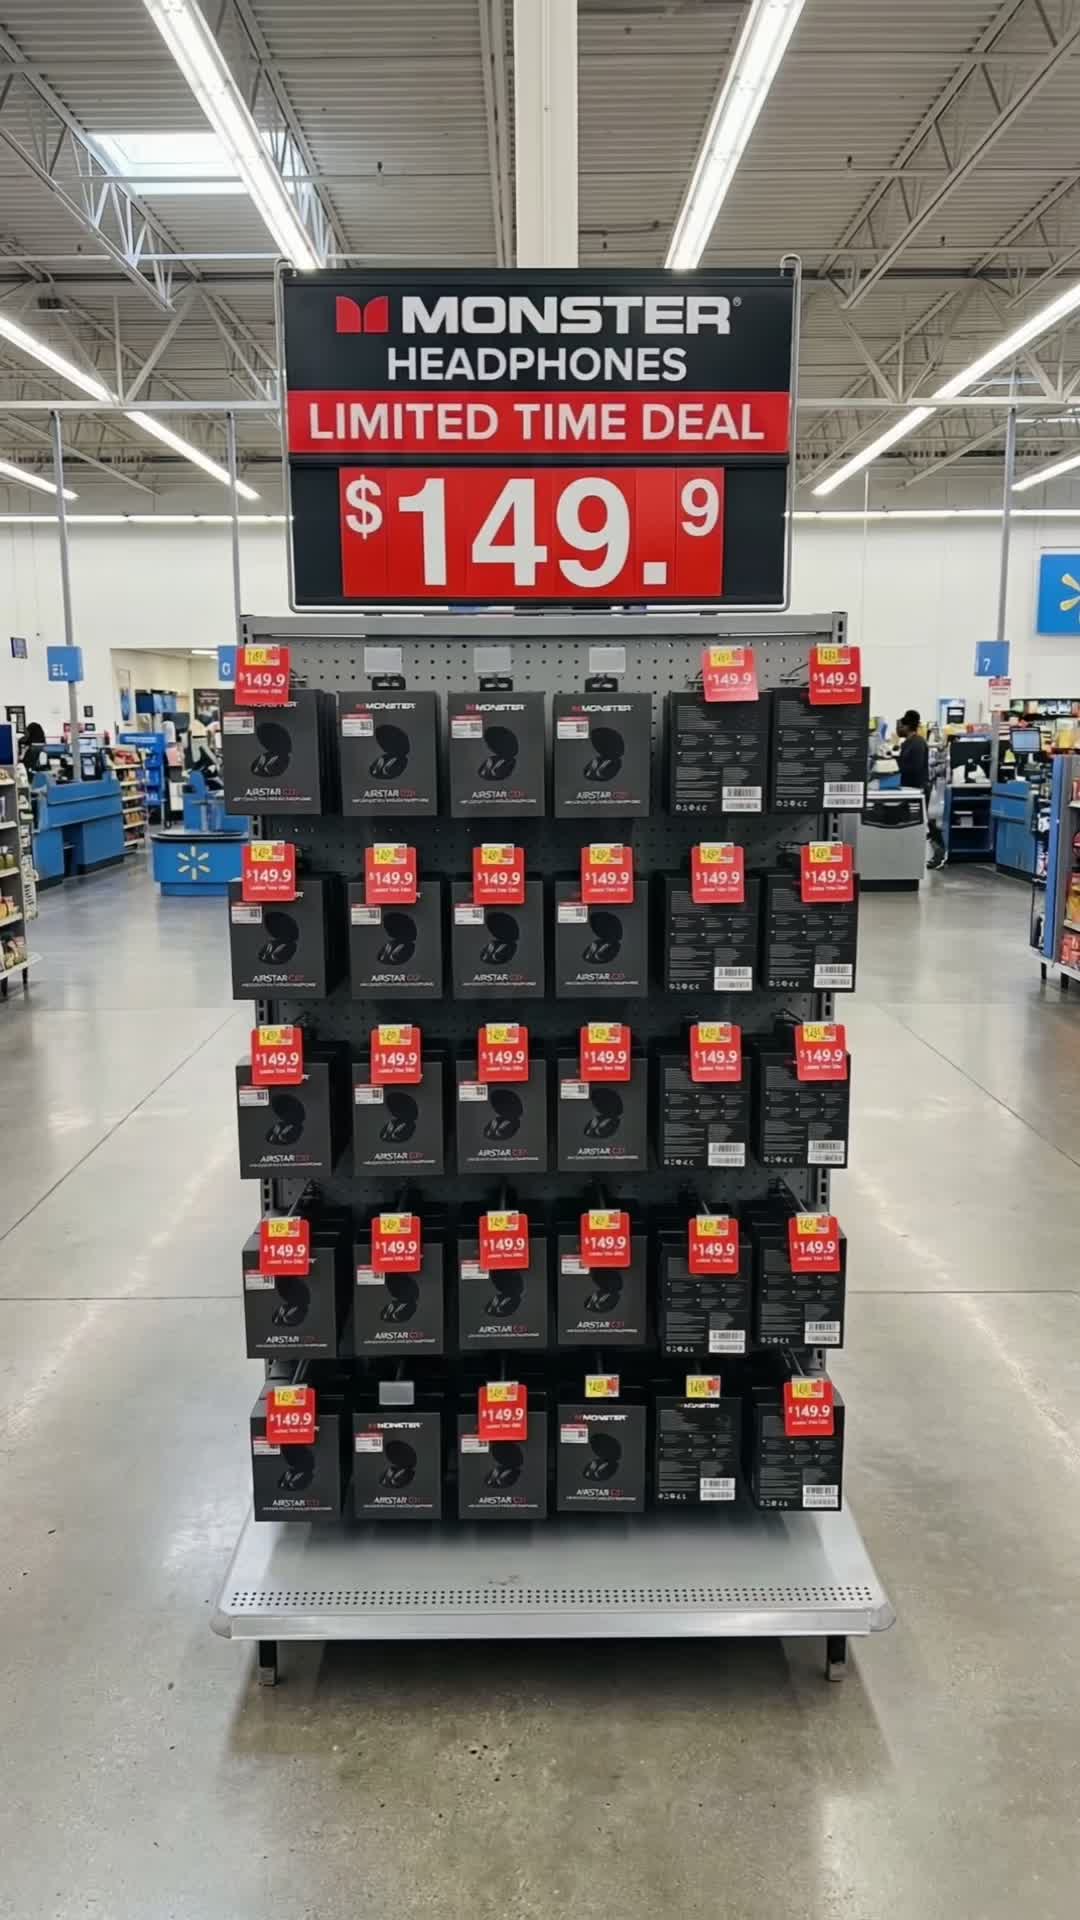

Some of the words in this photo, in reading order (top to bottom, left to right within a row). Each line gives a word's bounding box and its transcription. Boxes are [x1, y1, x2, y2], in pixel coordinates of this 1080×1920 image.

[402, 296, 731, 334] MONSTER
[388, 347, 687, 381] HEADPHONES
[309, 403, 498, 440] LIMITED
[514, 403, 626, 440] TIME
[642, 403, 764, 440] DEAL
